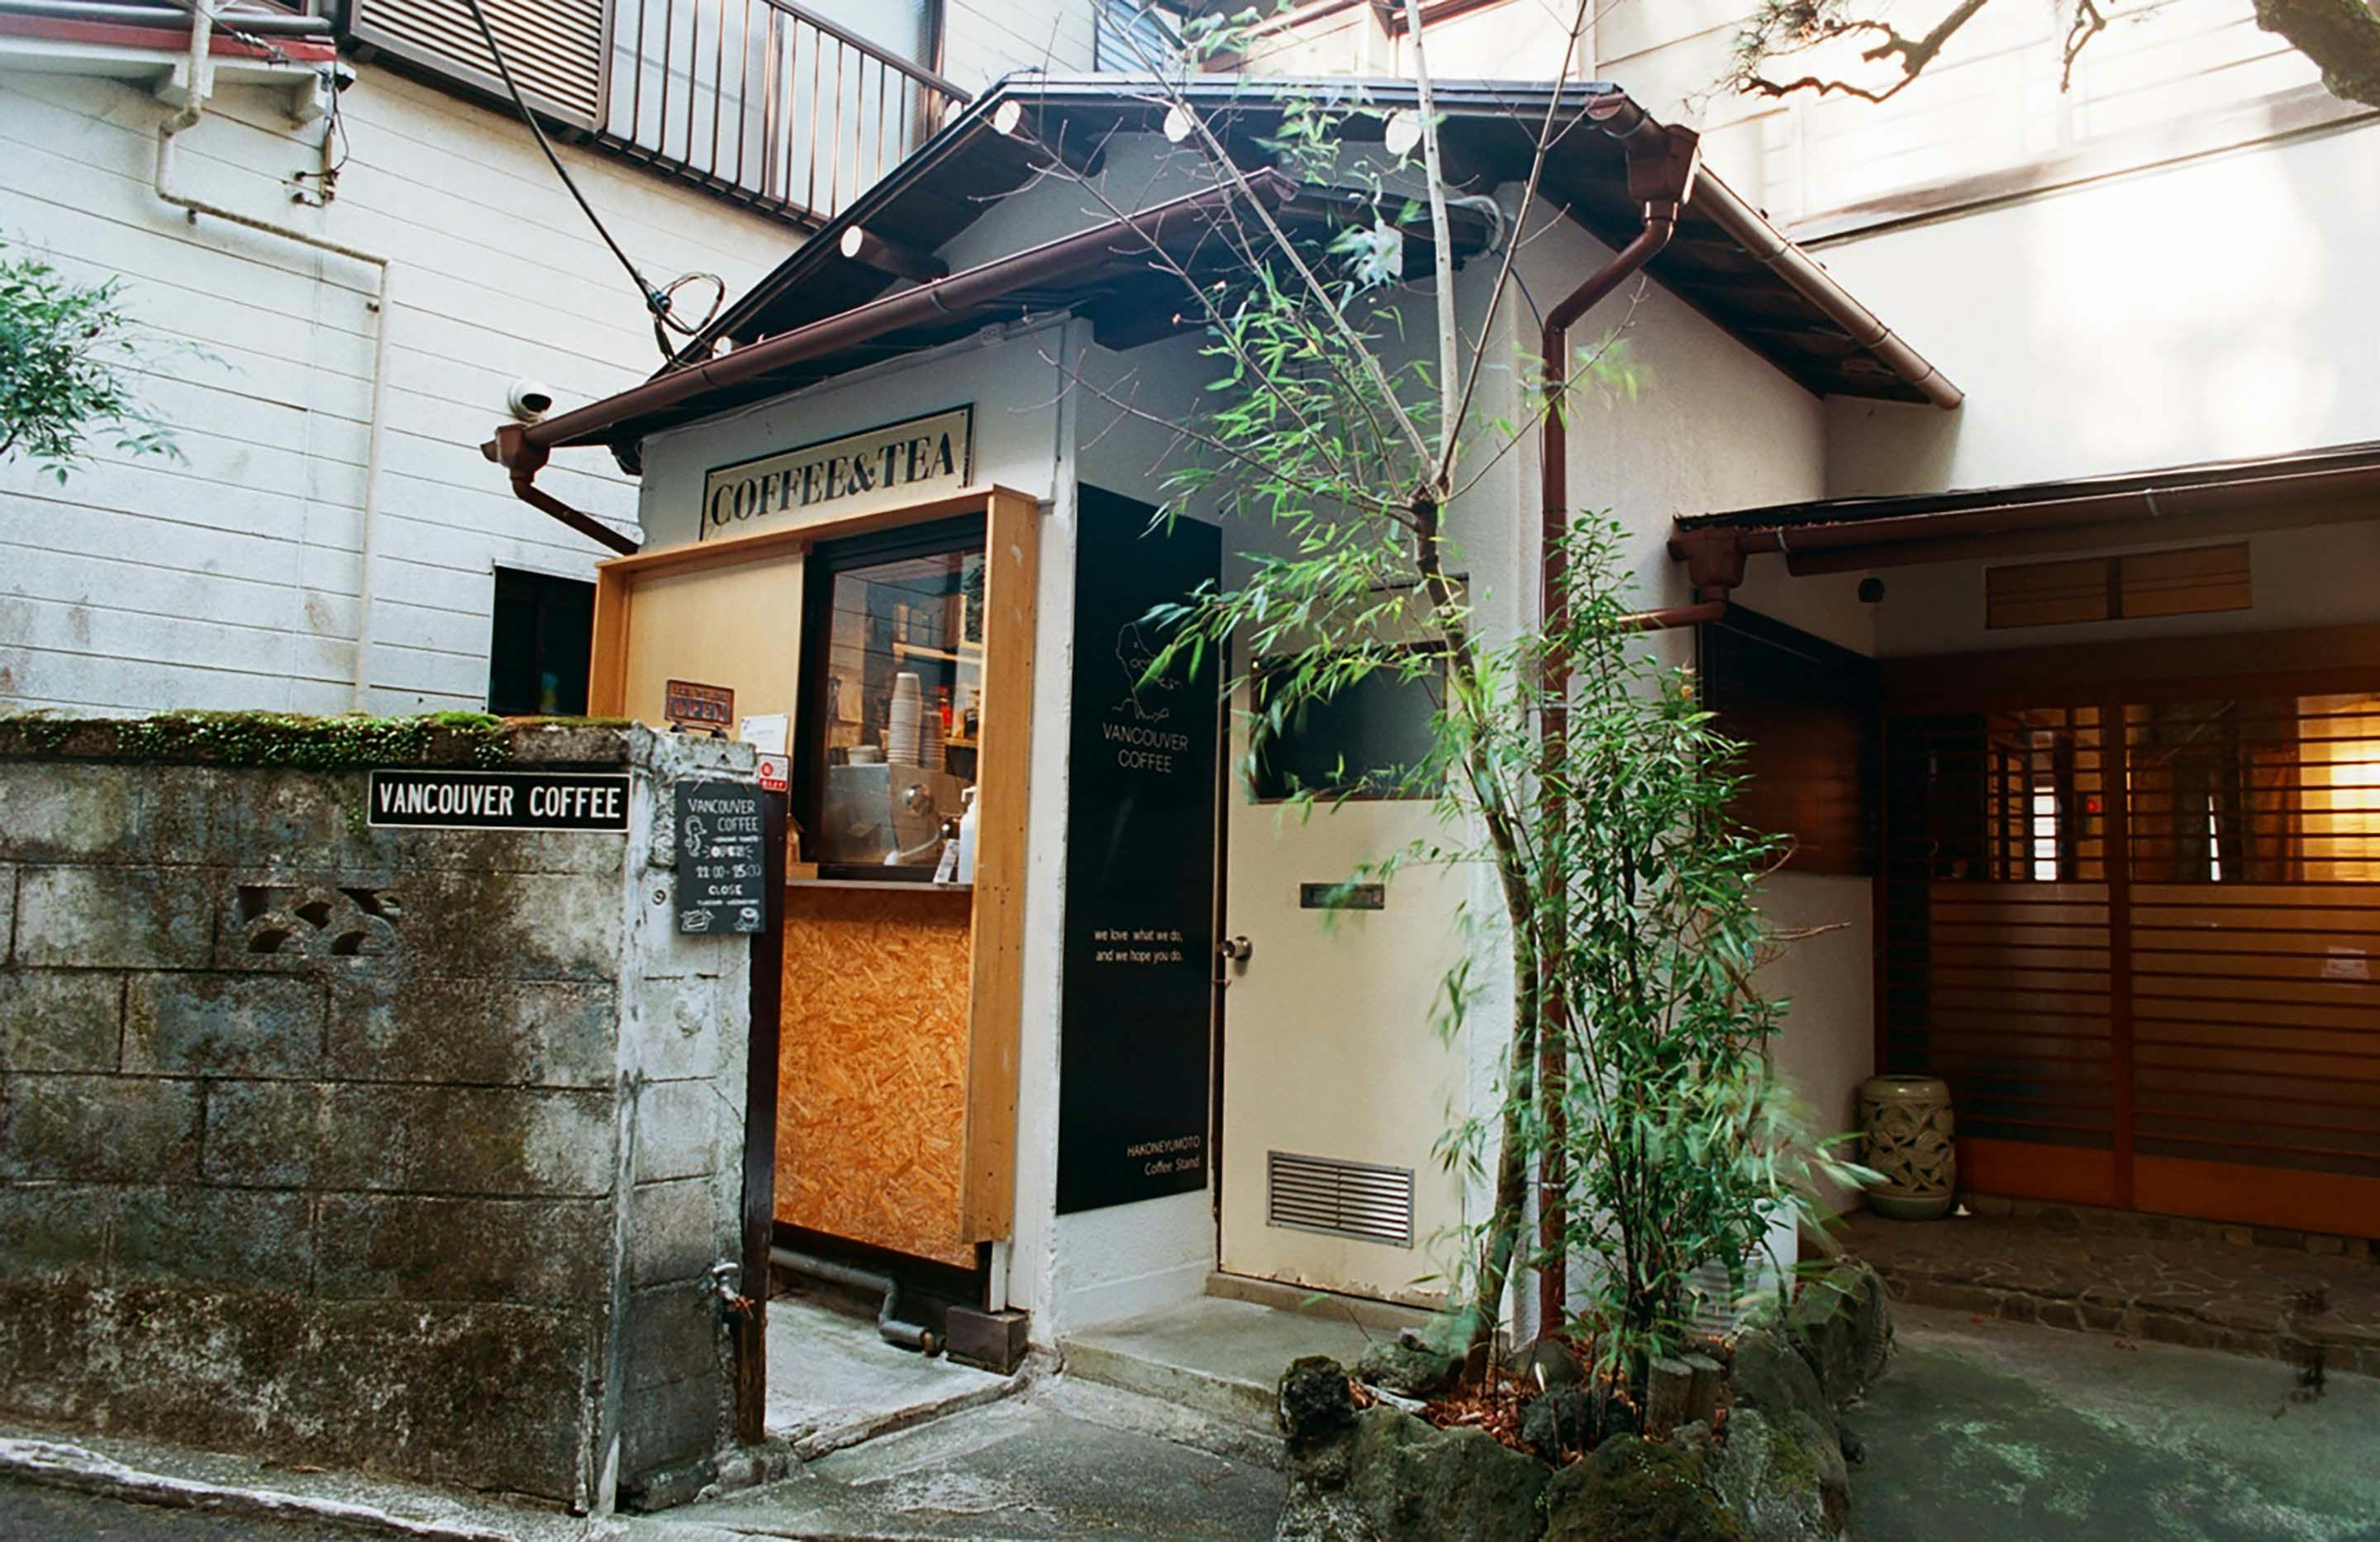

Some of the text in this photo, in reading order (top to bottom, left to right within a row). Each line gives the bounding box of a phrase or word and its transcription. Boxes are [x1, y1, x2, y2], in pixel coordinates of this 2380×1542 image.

[711, 431, 955, 526] COFFEE&TEA
[1102, 721, 1190, 751] VANCOUVER
[1118, 749, 1173, 773] COFFEE
[379, 783, 621, 819] VANCOUVER COFFEE
[688, 798, 756, 815] VANCOUVER
[716, 816, 759, 833] COFFEE
[1094, 930, 1108, 941] we
[1110, 927, 1128, 941] love
[1133, 927, 1154, 941] what
[1157, 930, 1168, 941] we
[1096, 949, 1114, 961] and
[1116, 950, 1128, 961] we
[1130, 948, 1151, 964] hope
[1153, 950, 1169, 964] you
[1126, 1135, 1202, 1158] HAKONEYUMOTO
[1144, 1154, 1201, 1176] Coffee Stand
